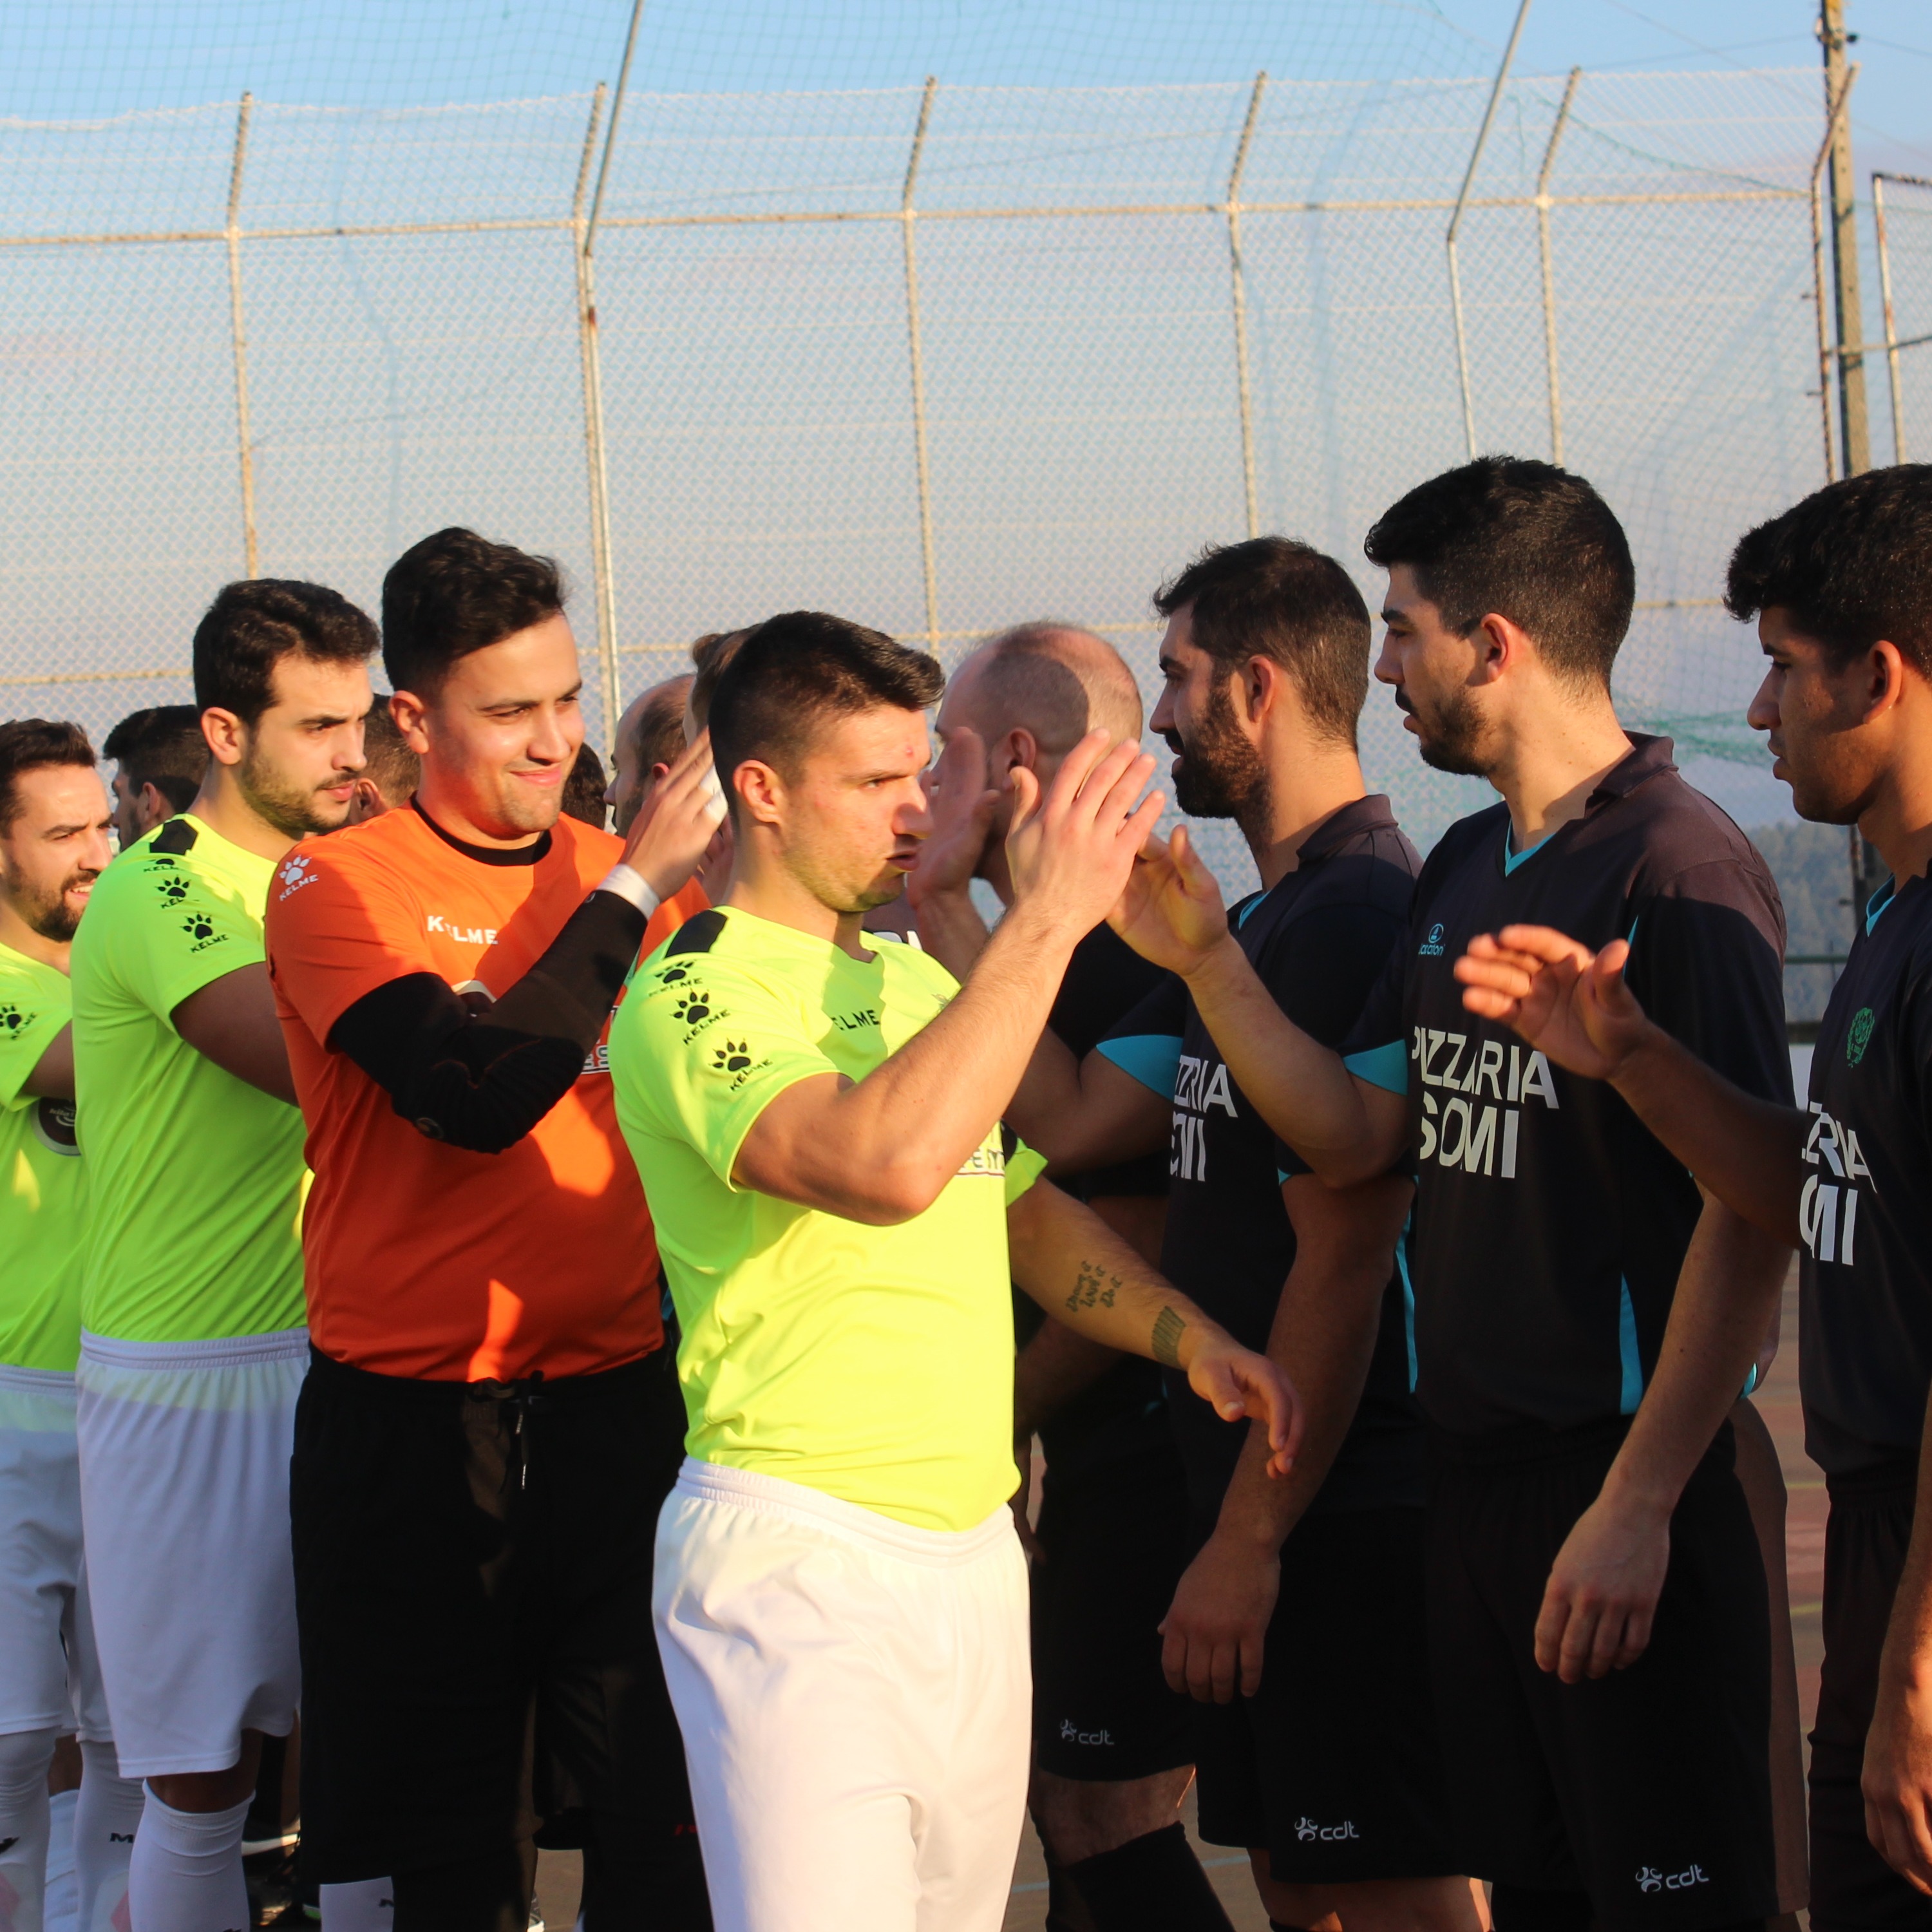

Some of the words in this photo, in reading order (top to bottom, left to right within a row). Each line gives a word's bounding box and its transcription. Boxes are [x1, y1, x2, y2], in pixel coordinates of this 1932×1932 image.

[279, 874, 319, 902] KELME
[191, 934, 229, 953] KELME
[683, 1009, 730, 1046] KELME
[1419, 1091, 1519, 1179] SOMI
[1078, 1729, 1115, 1745] cdt
[1320, 1821, 1359, 1841] cdt
[1665, 1864, 1710, 1889] cdt
